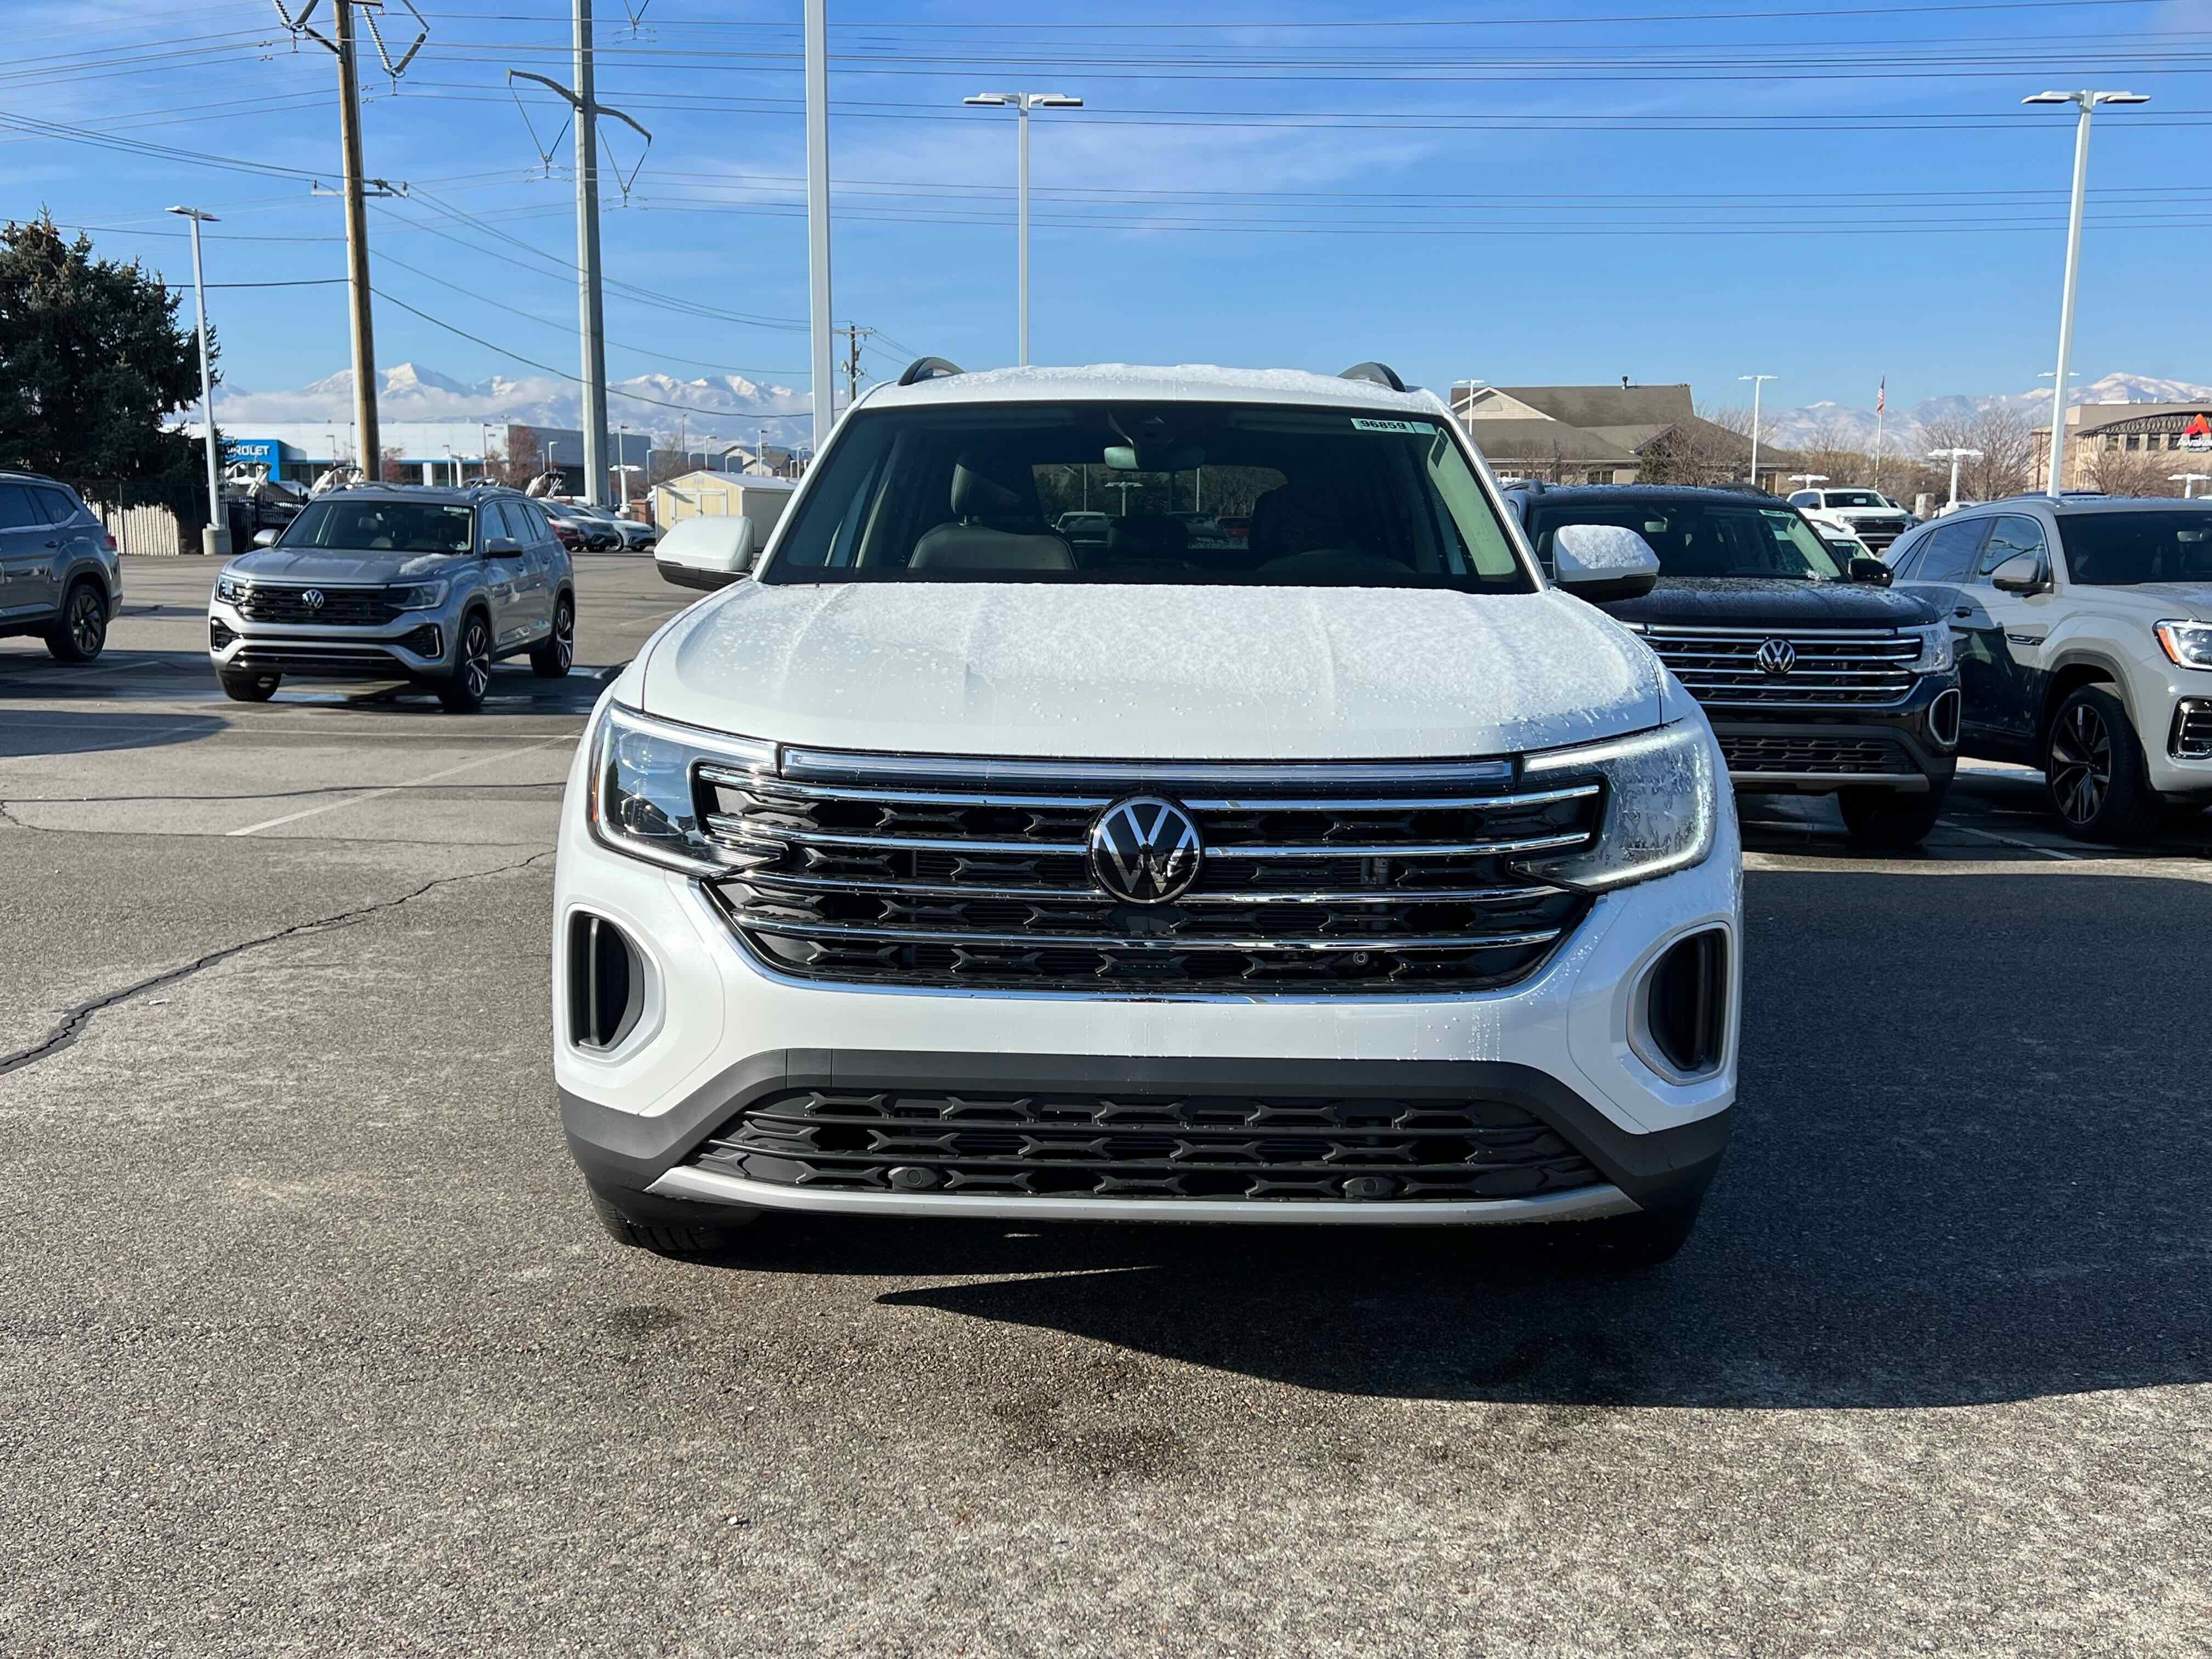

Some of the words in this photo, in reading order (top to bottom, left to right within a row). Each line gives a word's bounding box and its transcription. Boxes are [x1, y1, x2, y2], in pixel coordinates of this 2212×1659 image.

[1360, 420, 1407, 430] 96859
[1759, 639, 1795, 673] VW
[1093, 798, 1198, 901] VW
